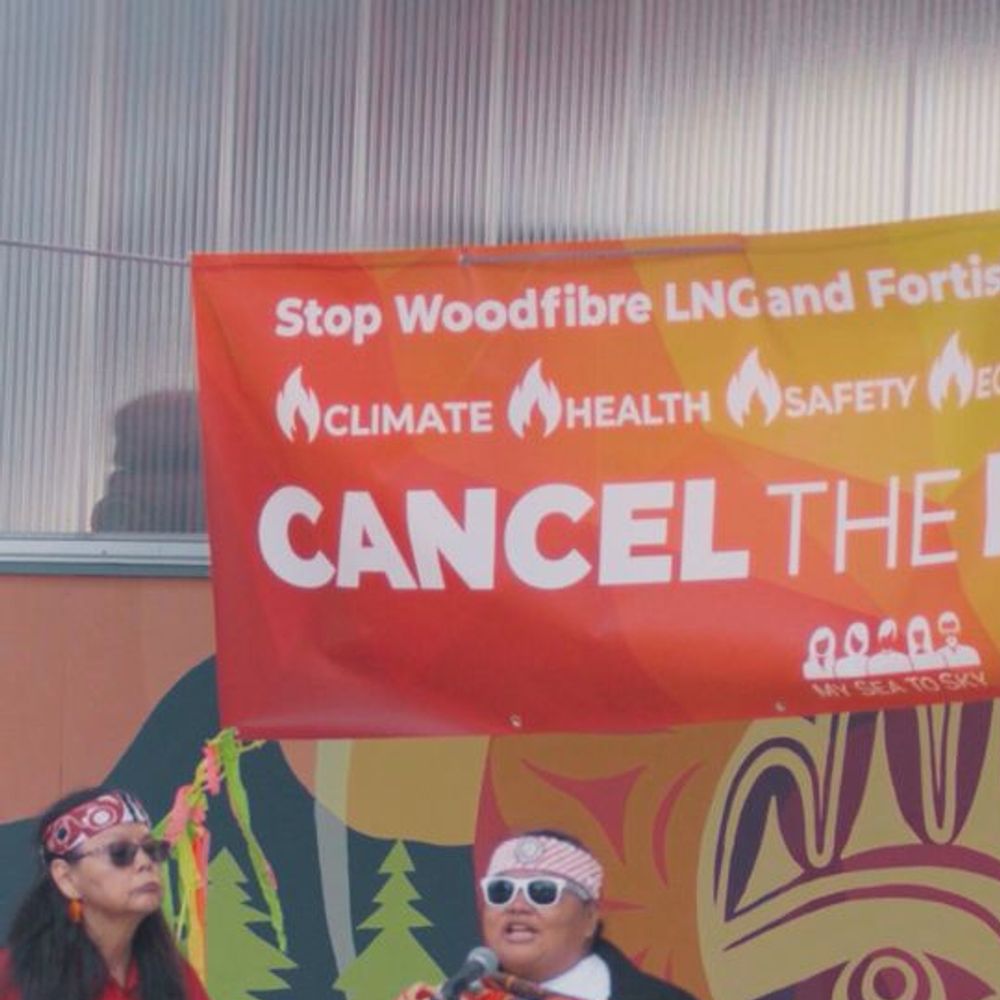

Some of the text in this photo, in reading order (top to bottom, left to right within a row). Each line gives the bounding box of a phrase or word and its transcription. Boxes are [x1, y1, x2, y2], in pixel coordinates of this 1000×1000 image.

[275, 297, 383, 345] Stop
[394, 282, 652, 334] Woodfibre
[665, 277, 760, 322] LNG
[766, 270, 855, 319] and
[323, 400, 493, 437] CLIMATE
[566, 390, 711, 430] HEALTH
[785, 375, 918, 418] SAFETY
[258, 477, 750, 591] CANCEL
[766, 468, 961, 577] THE
[811, 670, 989, 697] MY SEA TO SKY
